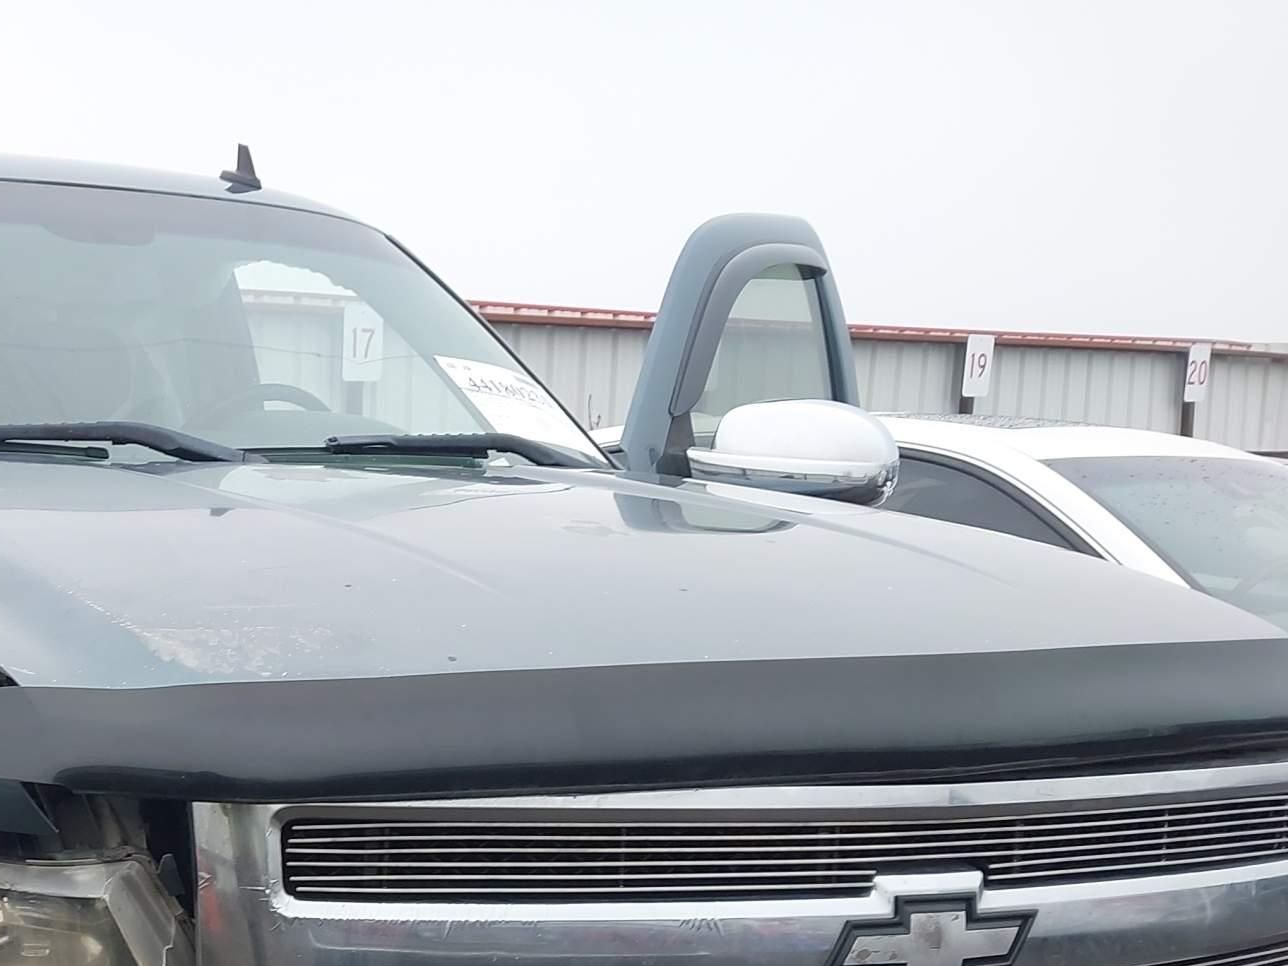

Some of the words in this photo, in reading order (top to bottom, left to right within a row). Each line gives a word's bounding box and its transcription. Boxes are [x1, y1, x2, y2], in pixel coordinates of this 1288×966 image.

[352, 327, 376, 359] 17
[969, 352, 987, 378] 19
[1187, 360, 1207, 385] 20
